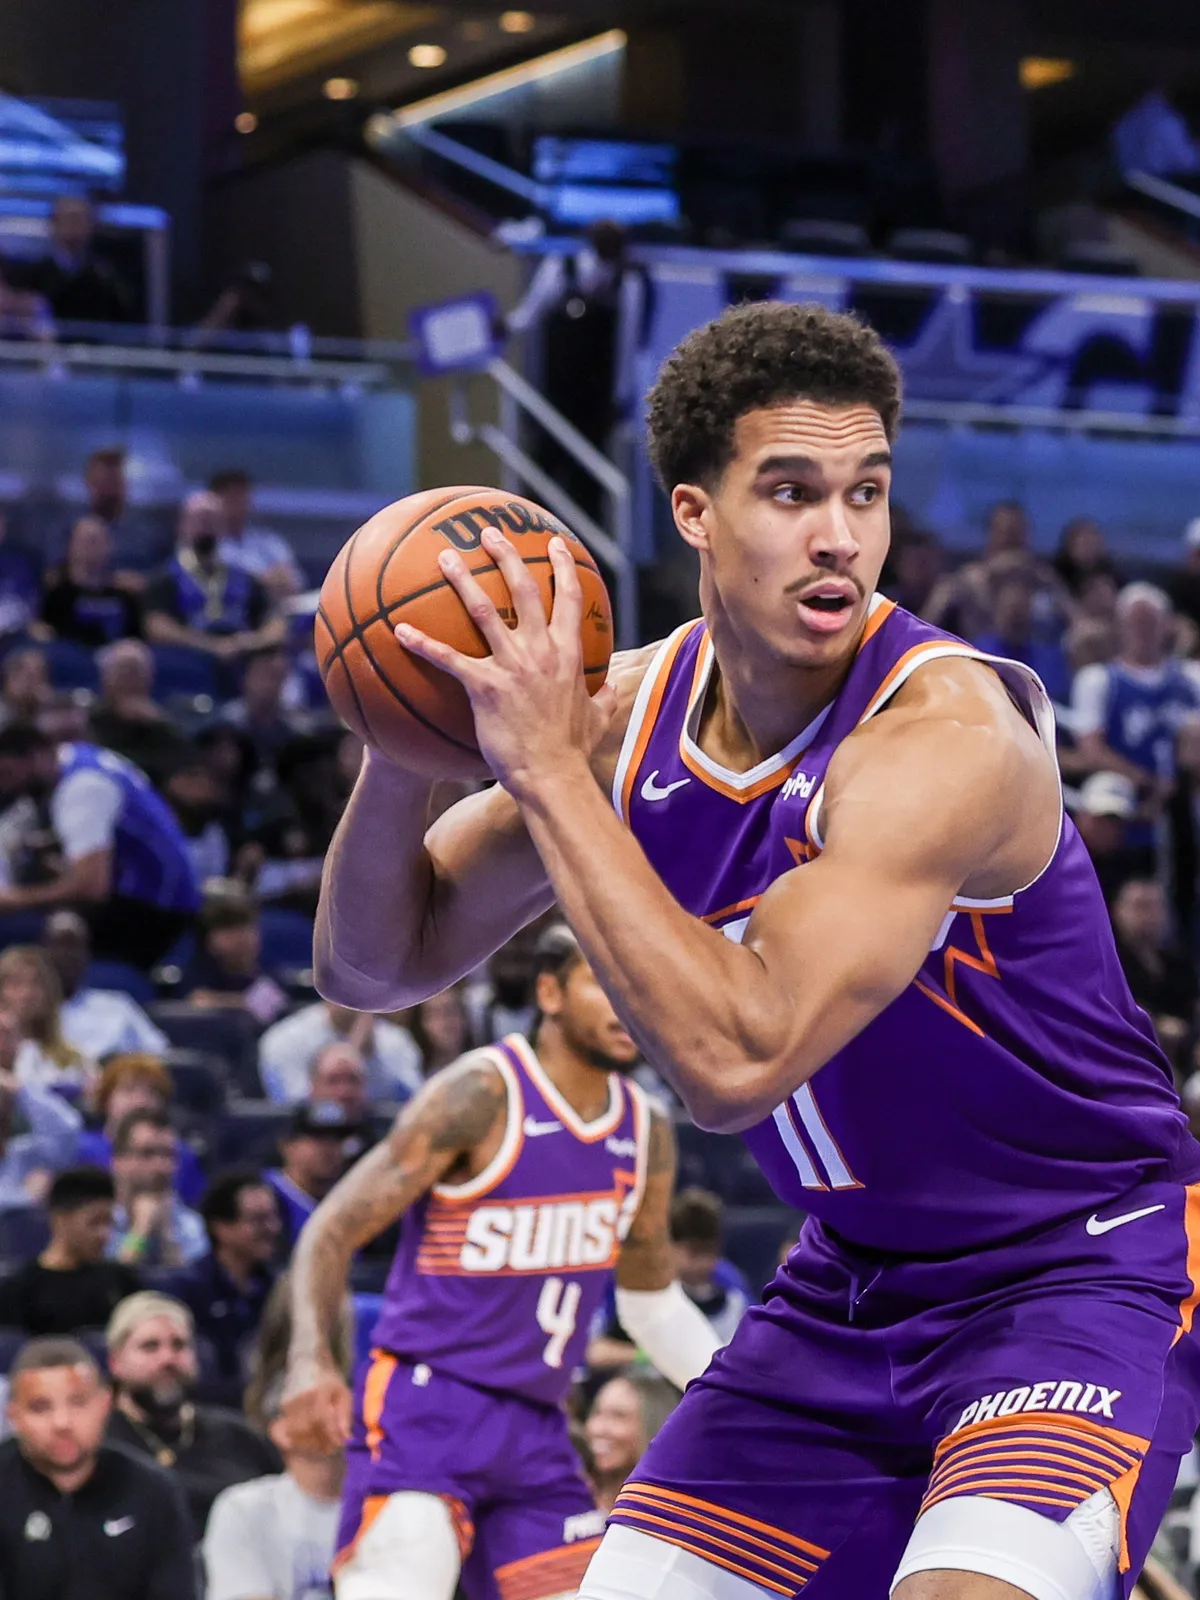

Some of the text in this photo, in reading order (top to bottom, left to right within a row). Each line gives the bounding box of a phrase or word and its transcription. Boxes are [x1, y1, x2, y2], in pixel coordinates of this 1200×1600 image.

[460, 1199, 619, 1272] SUNS
[536, 1276, 582, 1368] 4
[951, 1380, 1122, 1435] PHOENIX
